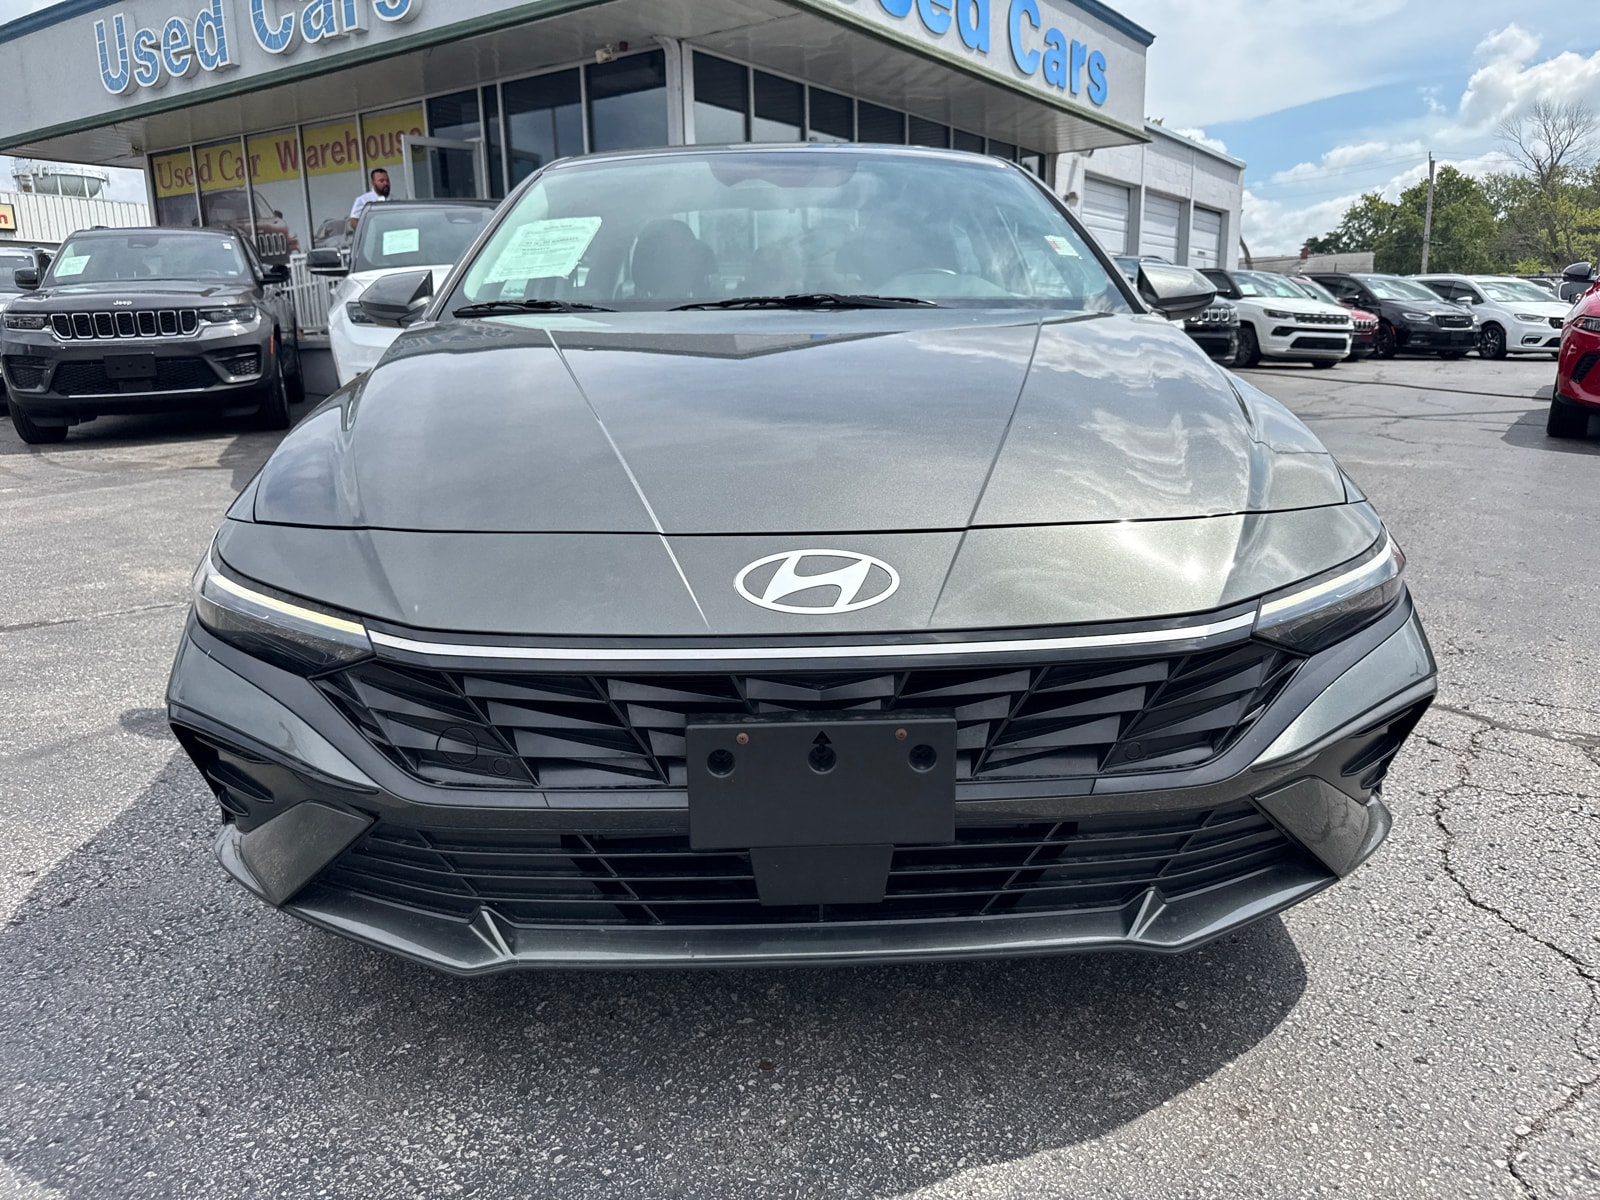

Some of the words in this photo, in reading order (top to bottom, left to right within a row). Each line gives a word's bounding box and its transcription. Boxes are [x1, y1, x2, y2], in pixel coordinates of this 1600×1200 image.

[93, 0, 230, 95] Used
[1007, 0, 1108, 106] Cars
[156, 152, 214, 191] Used
[218, 149, 261, 181] Car
